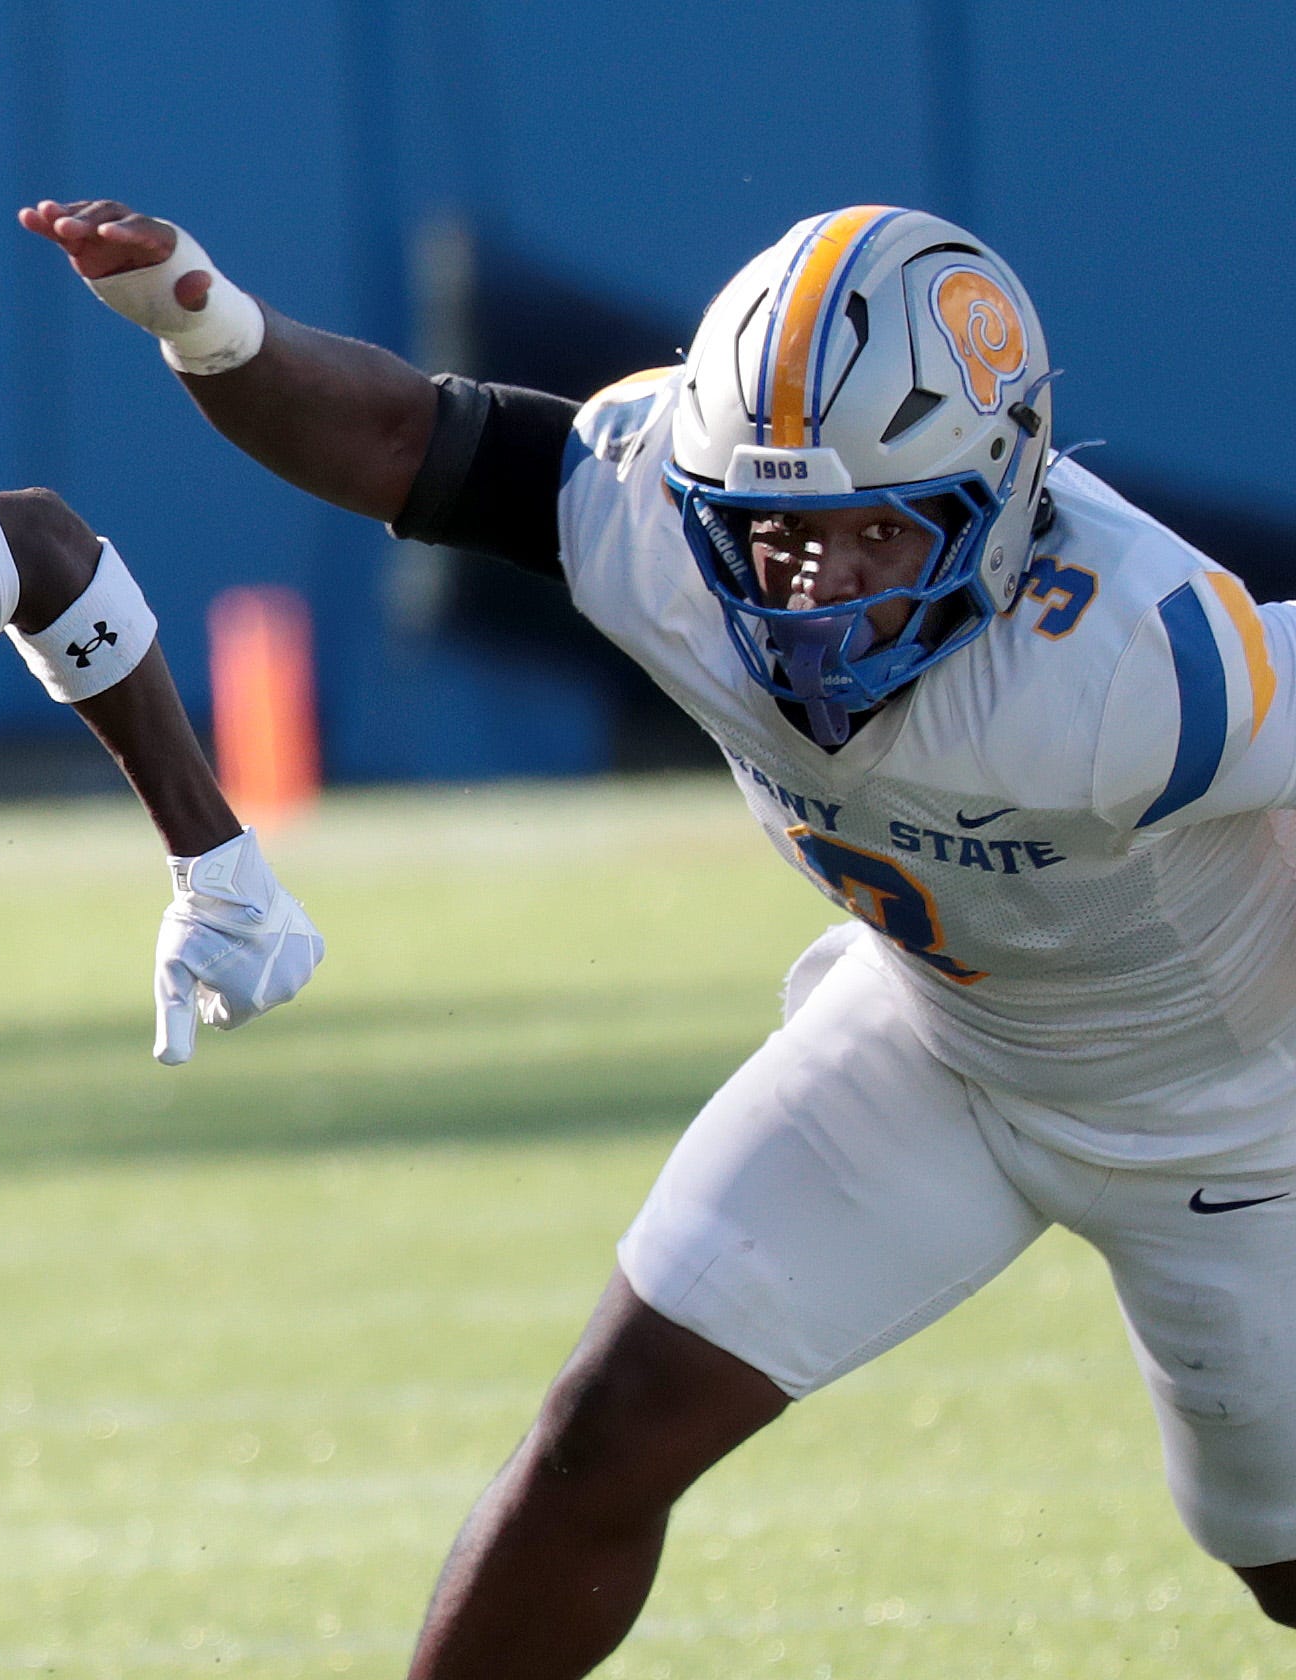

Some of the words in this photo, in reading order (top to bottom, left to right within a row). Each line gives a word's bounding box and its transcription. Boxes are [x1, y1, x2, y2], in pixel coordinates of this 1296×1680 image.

[753, 460, 808, 480] 1903
[997, 554, 1099, 641] 3
[889, 820, 1067, 875] STATE
